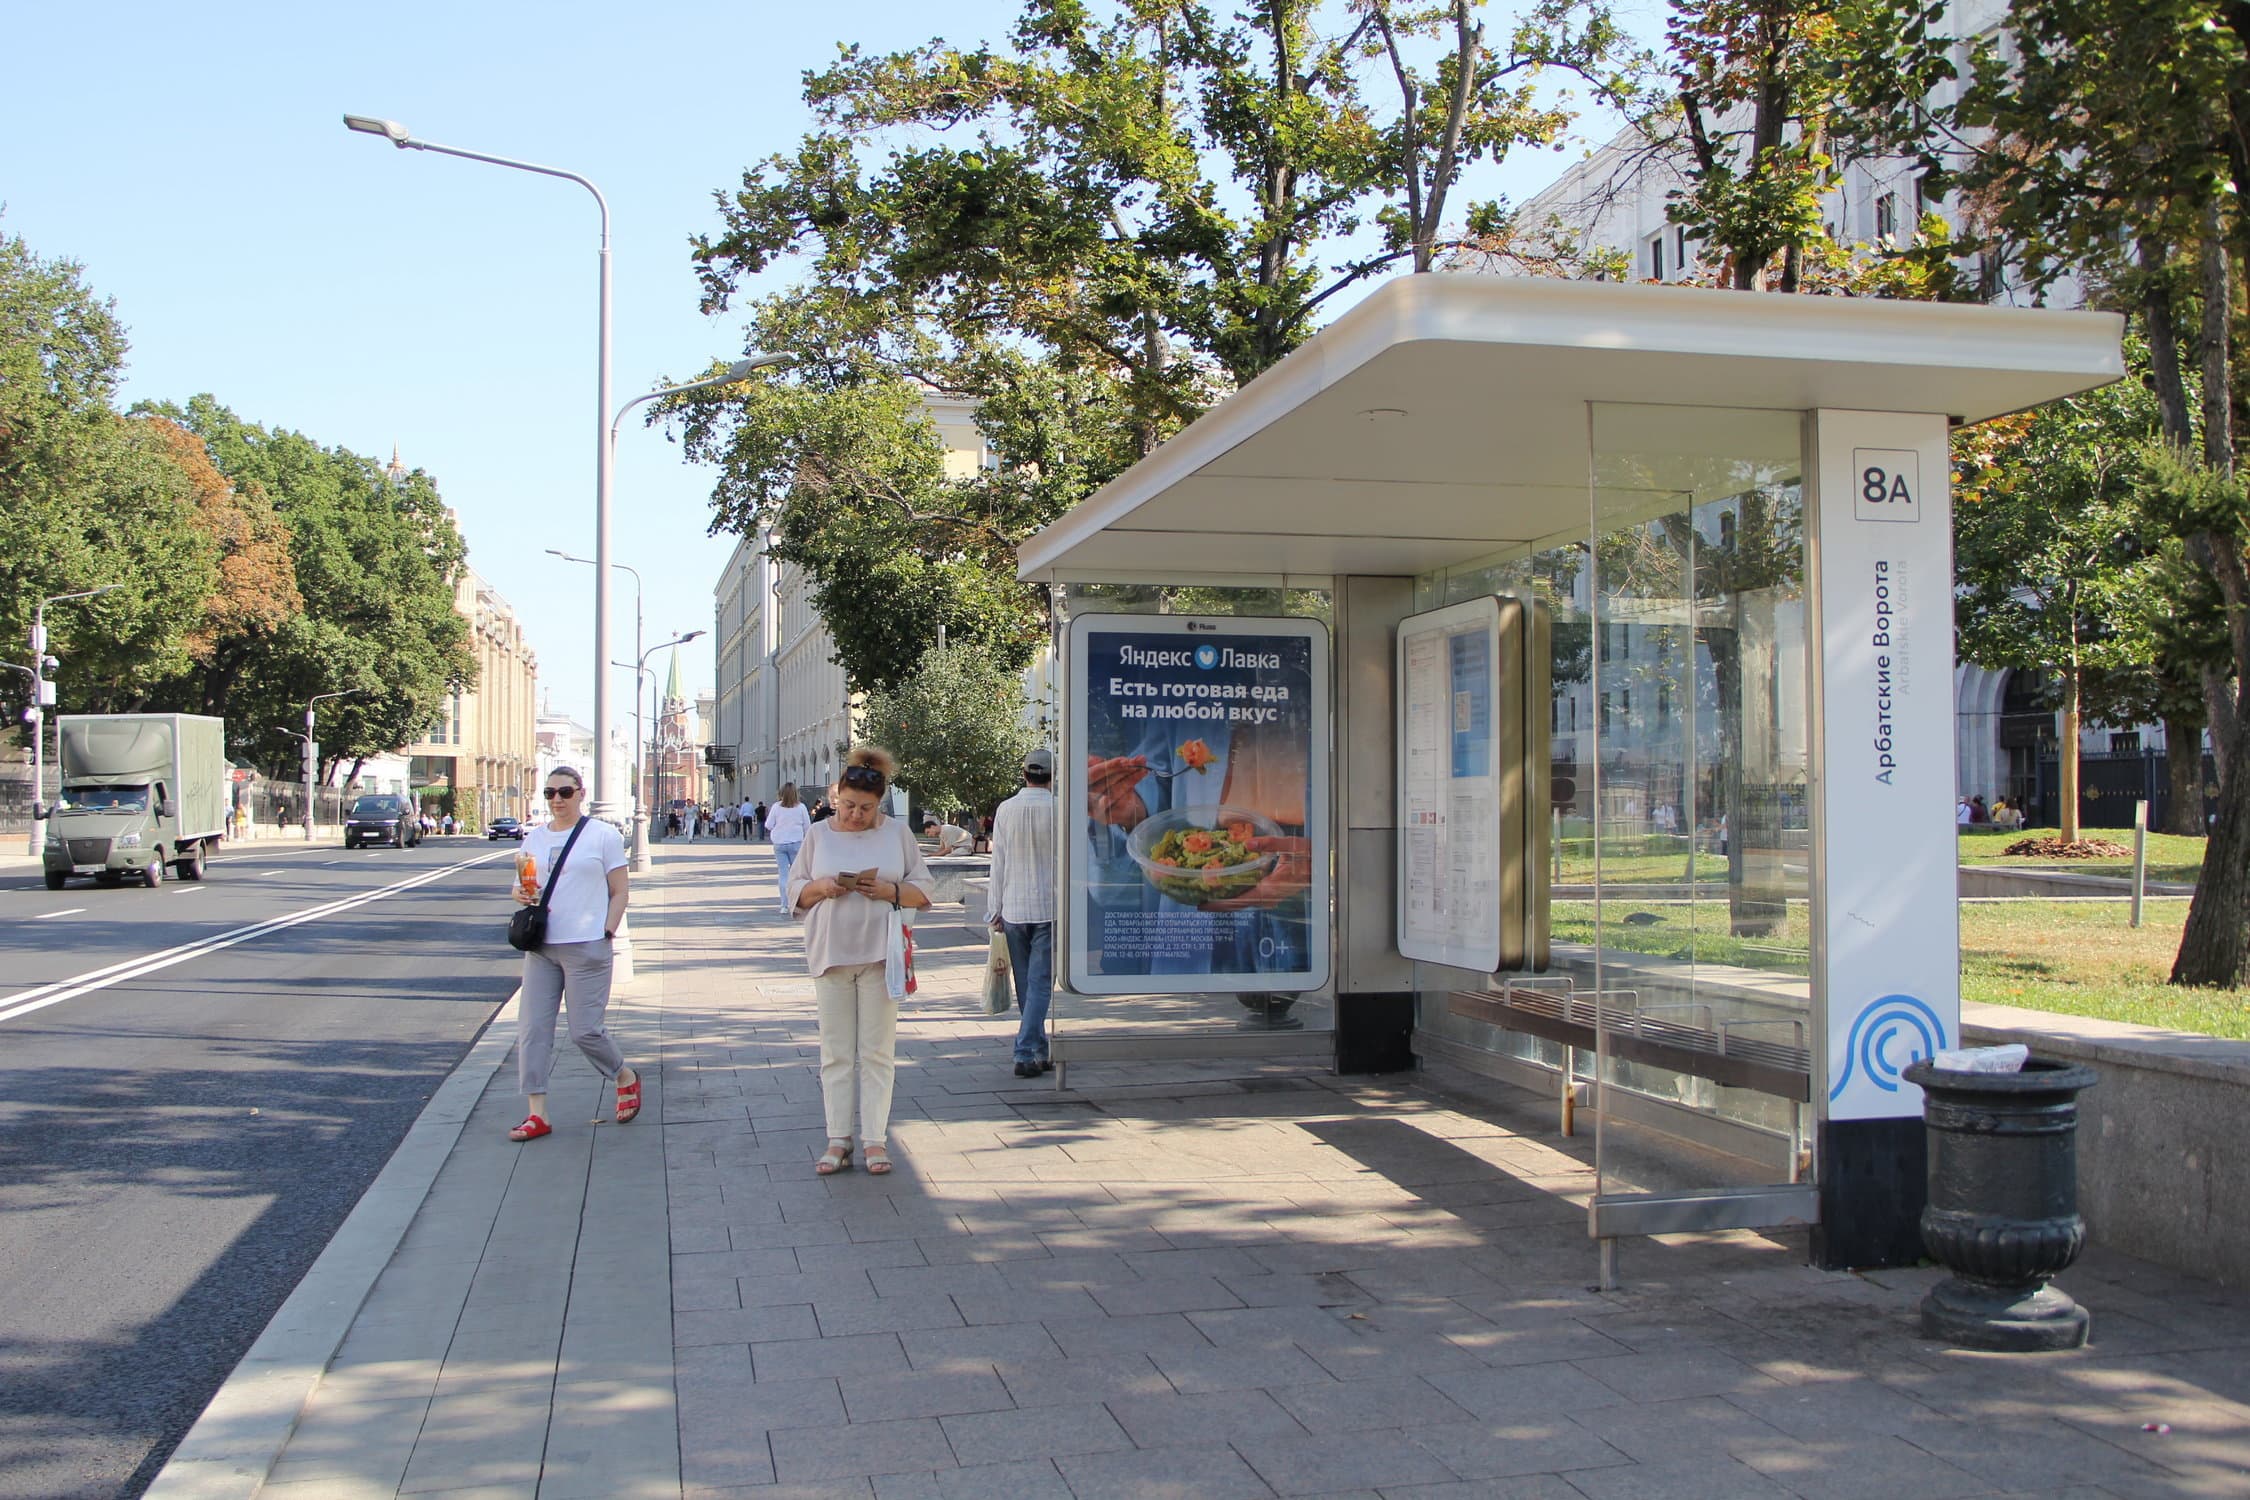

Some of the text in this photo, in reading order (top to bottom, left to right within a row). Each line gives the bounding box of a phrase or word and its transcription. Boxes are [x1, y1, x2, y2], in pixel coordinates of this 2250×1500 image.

[1895, 560, 1911, 695] Arbatskie Vorota
[1120, 644, 1280, 670] Яндекс Лавка
[1873, 560, 1896, 786] Арбатские Ворота
[1109, 677, 1289, 703] Есть готовая еда
[1121, 701, 1278, 725] на любой вкус
[1259, 937, 1289, 958] 0+
